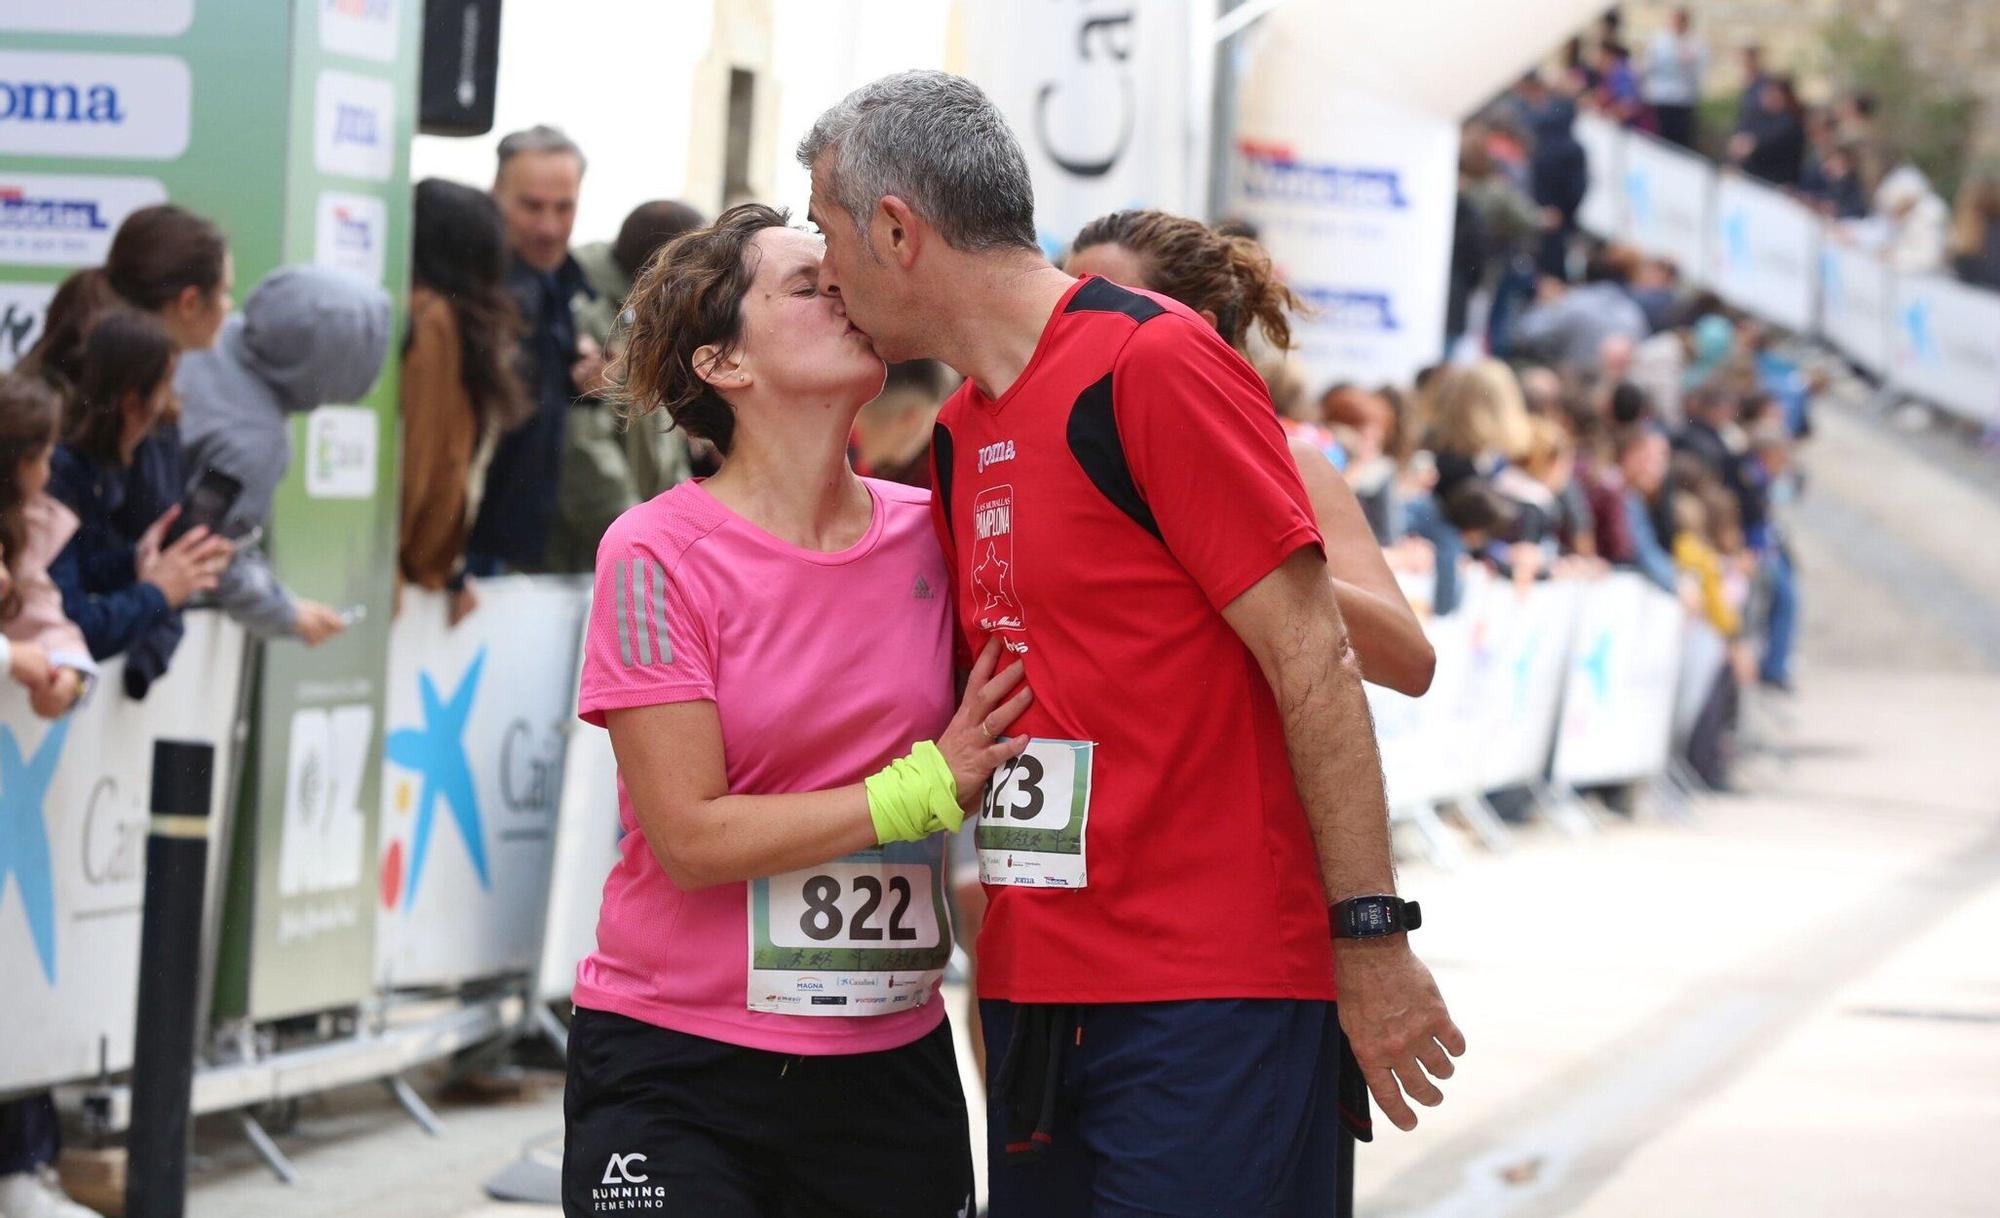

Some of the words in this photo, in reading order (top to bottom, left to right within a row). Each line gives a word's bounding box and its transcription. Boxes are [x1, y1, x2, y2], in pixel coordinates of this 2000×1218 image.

[976, 505, 1010, 541] PAMPLONA
[800, 875, 917, 941] 822
[601, 1152, 649, 1184] AC
[592, 1186, 666, 1200] RUNNING
[594, 1199, 664, 1211] FEMENINO
